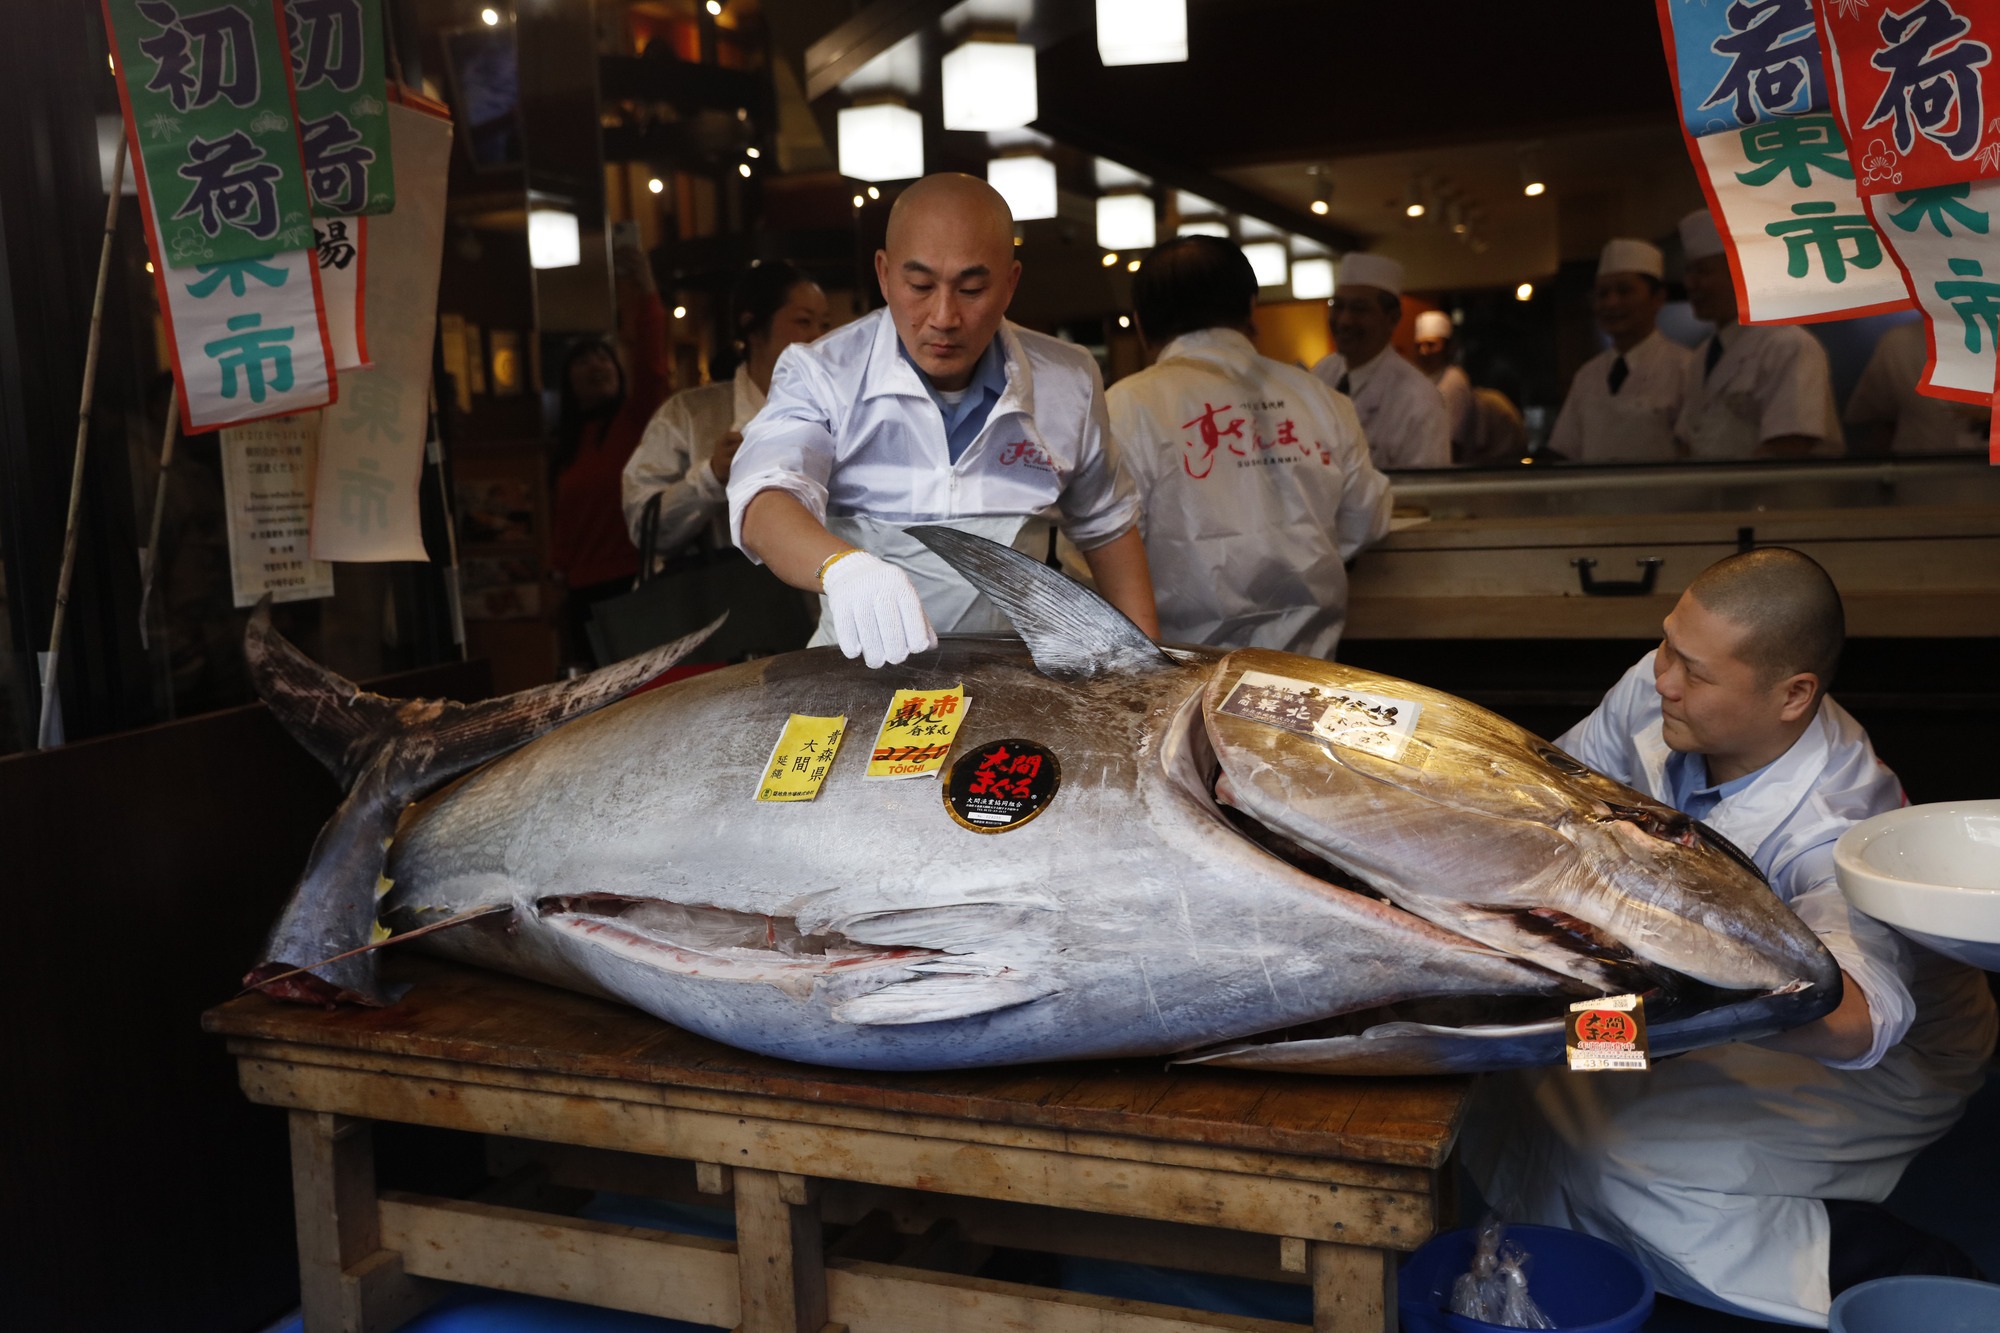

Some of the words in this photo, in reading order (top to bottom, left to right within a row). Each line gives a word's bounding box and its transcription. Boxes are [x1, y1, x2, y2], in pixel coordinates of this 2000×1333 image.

[1863, 0, 1992, 161] 荷
[135, 0, 283, 240] 初荷
[1735, 115, 1883, 284] 東市
[791, 739, 818, 773] 大間
[808, 729, 841, 782] 青森県
[979, 746, 1042, 778] 大間
[969, 769, 1032, 799] まぐろ
[1585, 1013, 1625, 1029] 大間
[1585, 1027, 1626, 1042] まぐろ
